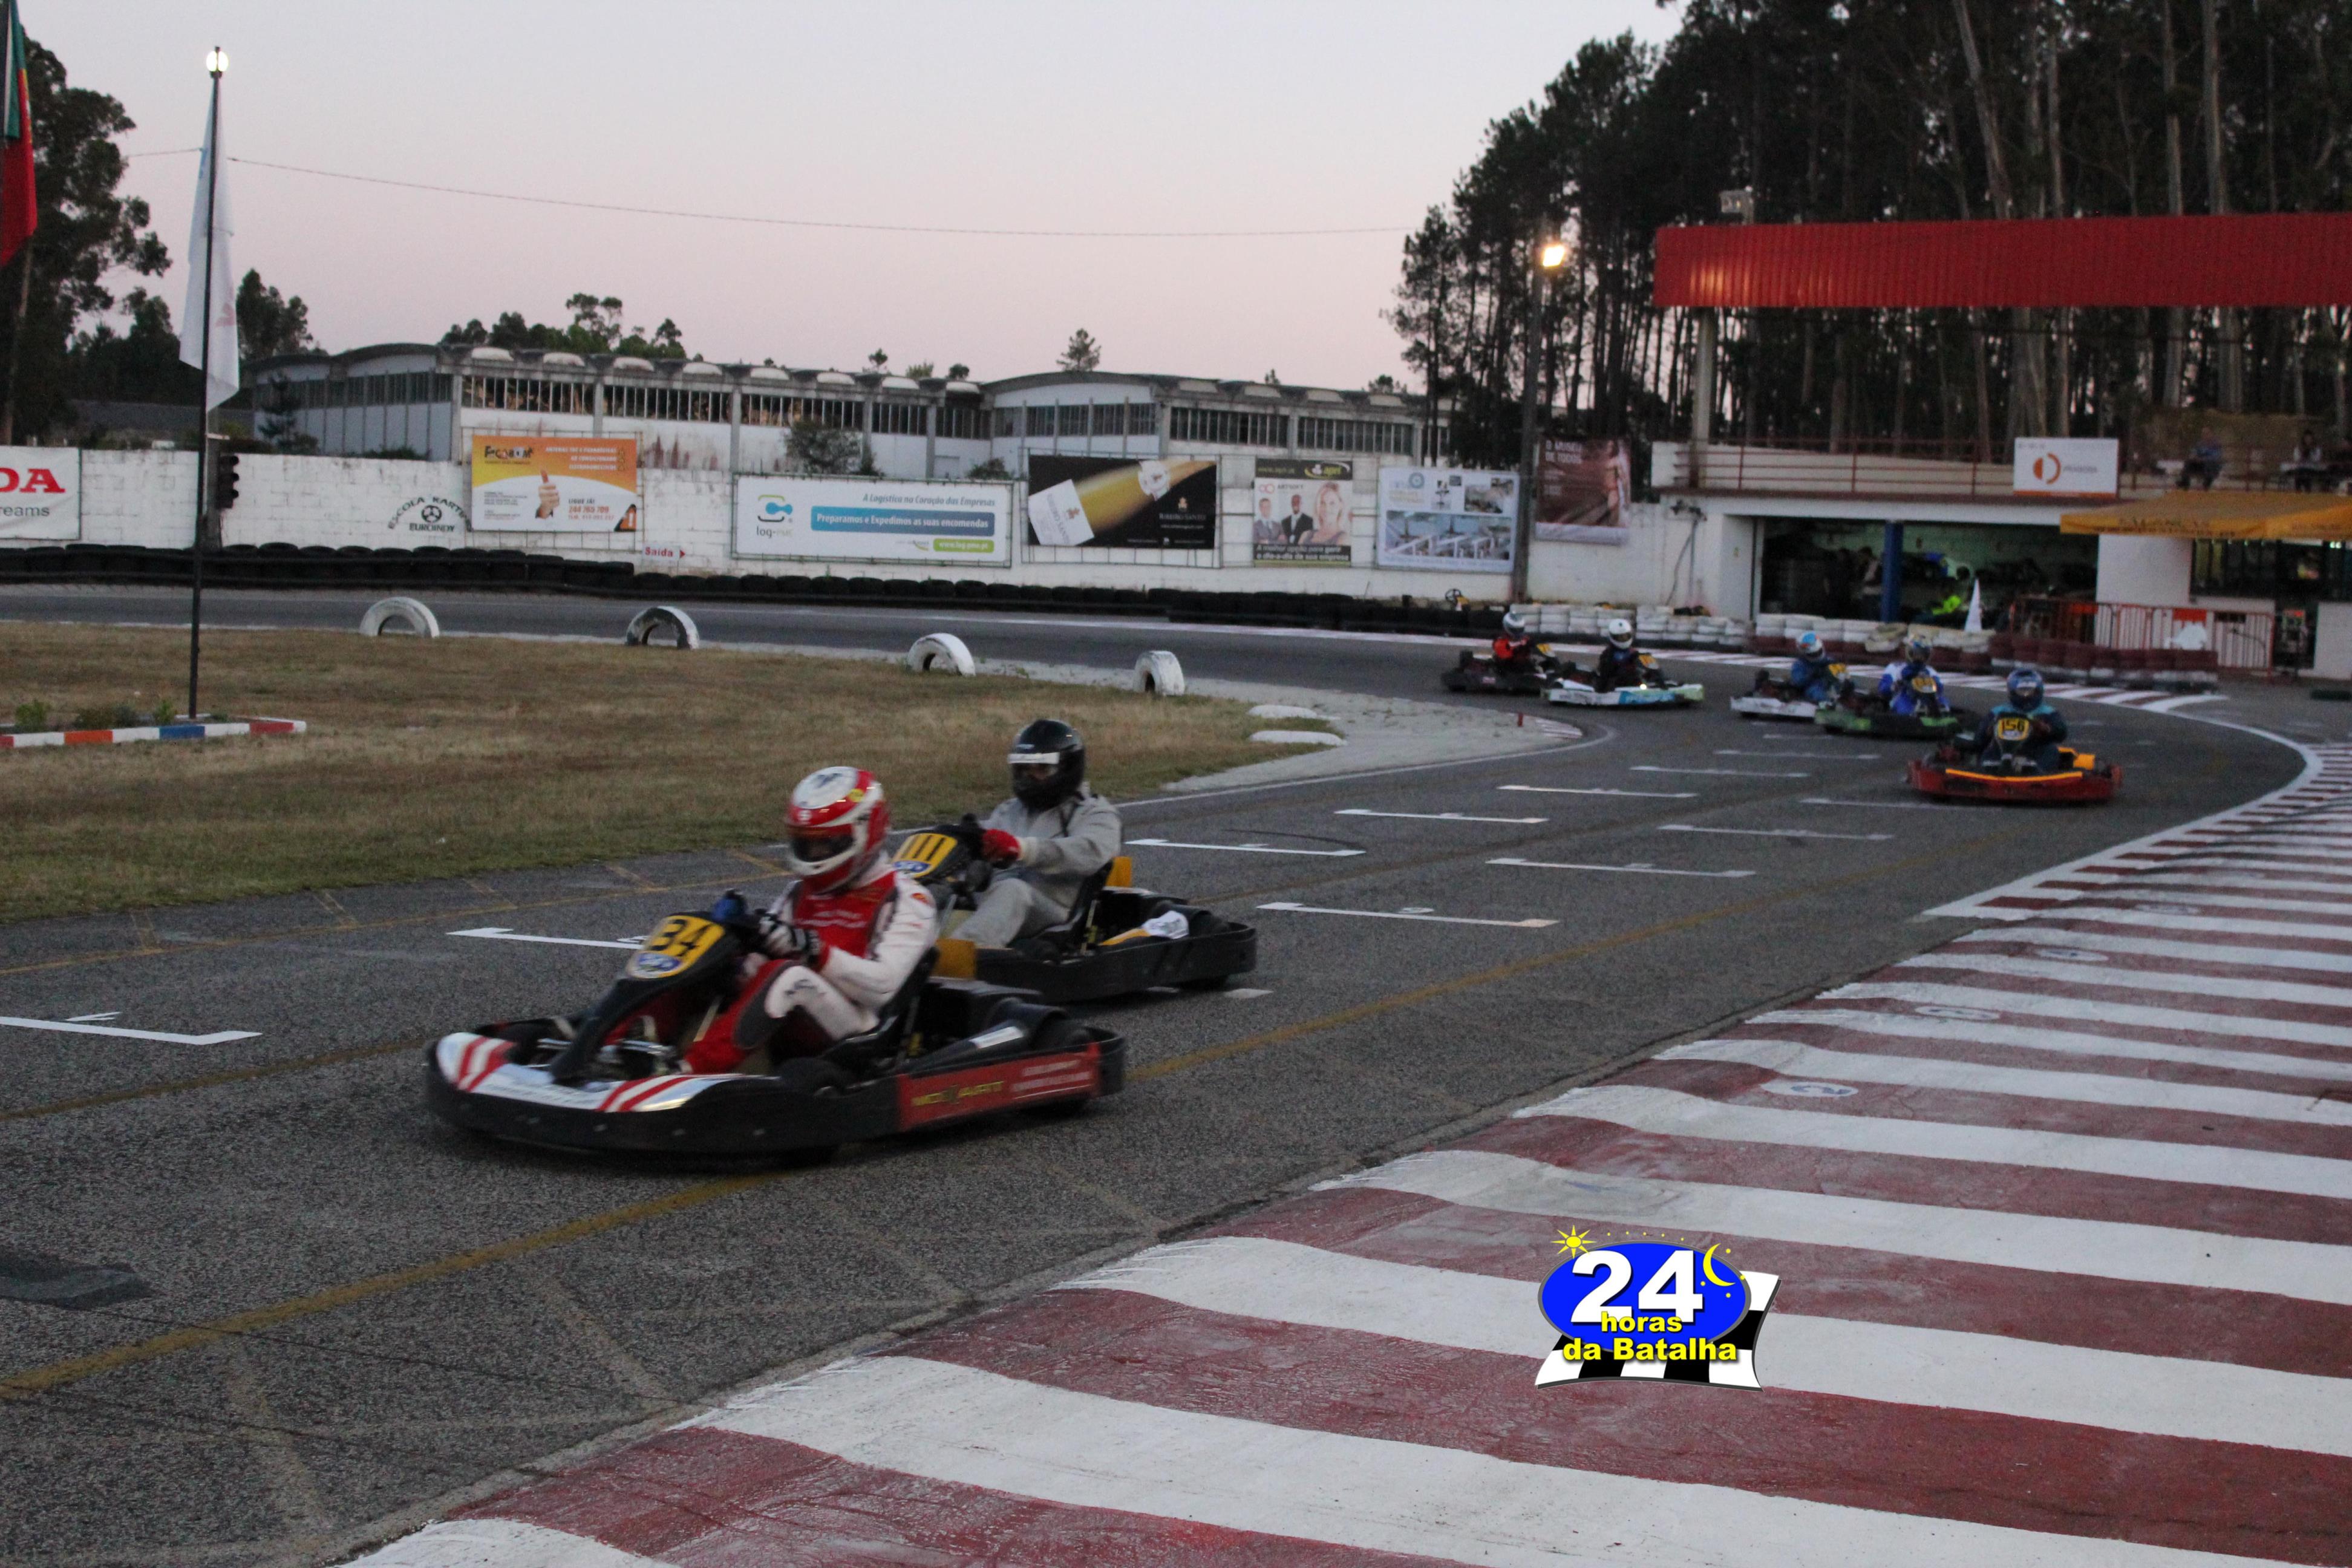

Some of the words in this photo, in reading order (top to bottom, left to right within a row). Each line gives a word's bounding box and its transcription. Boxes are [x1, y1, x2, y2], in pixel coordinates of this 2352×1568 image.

[388, 497, 425, 529] ESCOLA
[946, 496, 958, 505] das
[960, 497, 995, 507] Empresas
[817, 514, 863, 524] Preparamos
[871, 515, 912, 526] Expedimos
[941, 518, 988, 528] encomendas
[651, 919, 711, 957] 34
